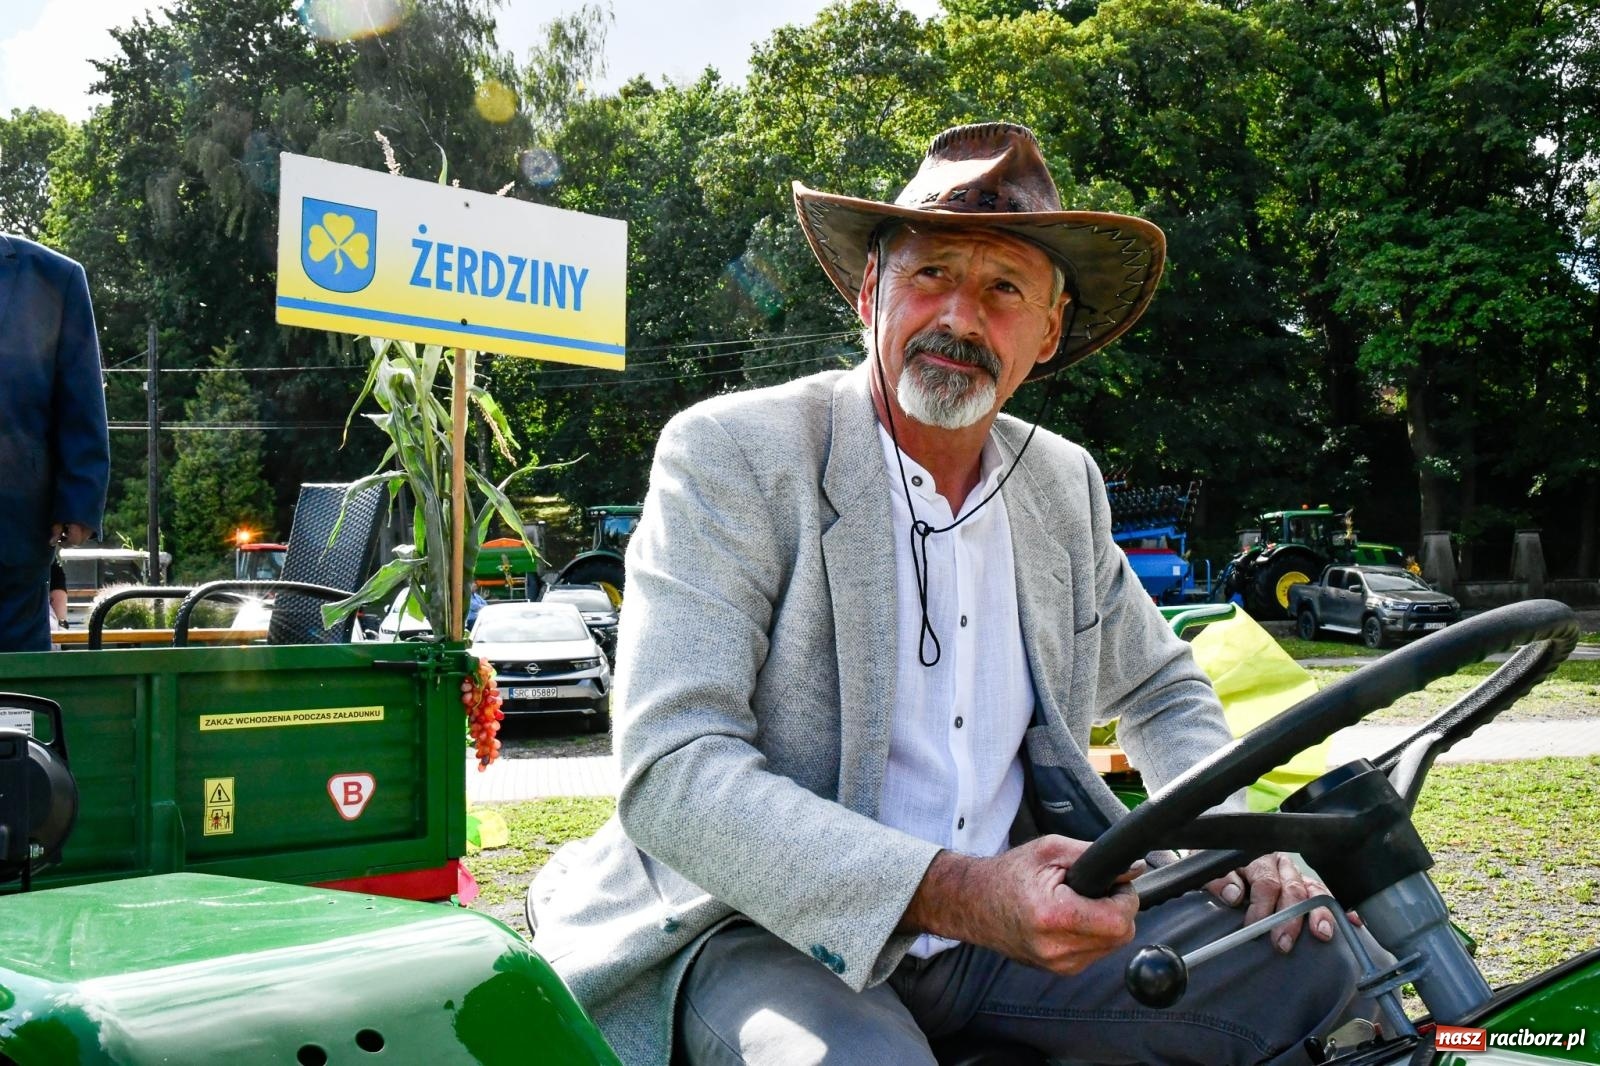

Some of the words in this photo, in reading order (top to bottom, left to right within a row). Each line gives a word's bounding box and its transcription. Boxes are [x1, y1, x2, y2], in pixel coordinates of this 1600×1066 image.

[410, 224, 589, 312] ŻERDZINY
[531, 688, 556, 697] 05889
[205, 718, 234, 726] ZAKAZ
[236, 714, 291, 725] WCHODZENIA
[293, 711, 332, 721] PODCZAS
[333, 710, 380, 719] ZAŁADUNKU
[343, 781, 363, 806] B
